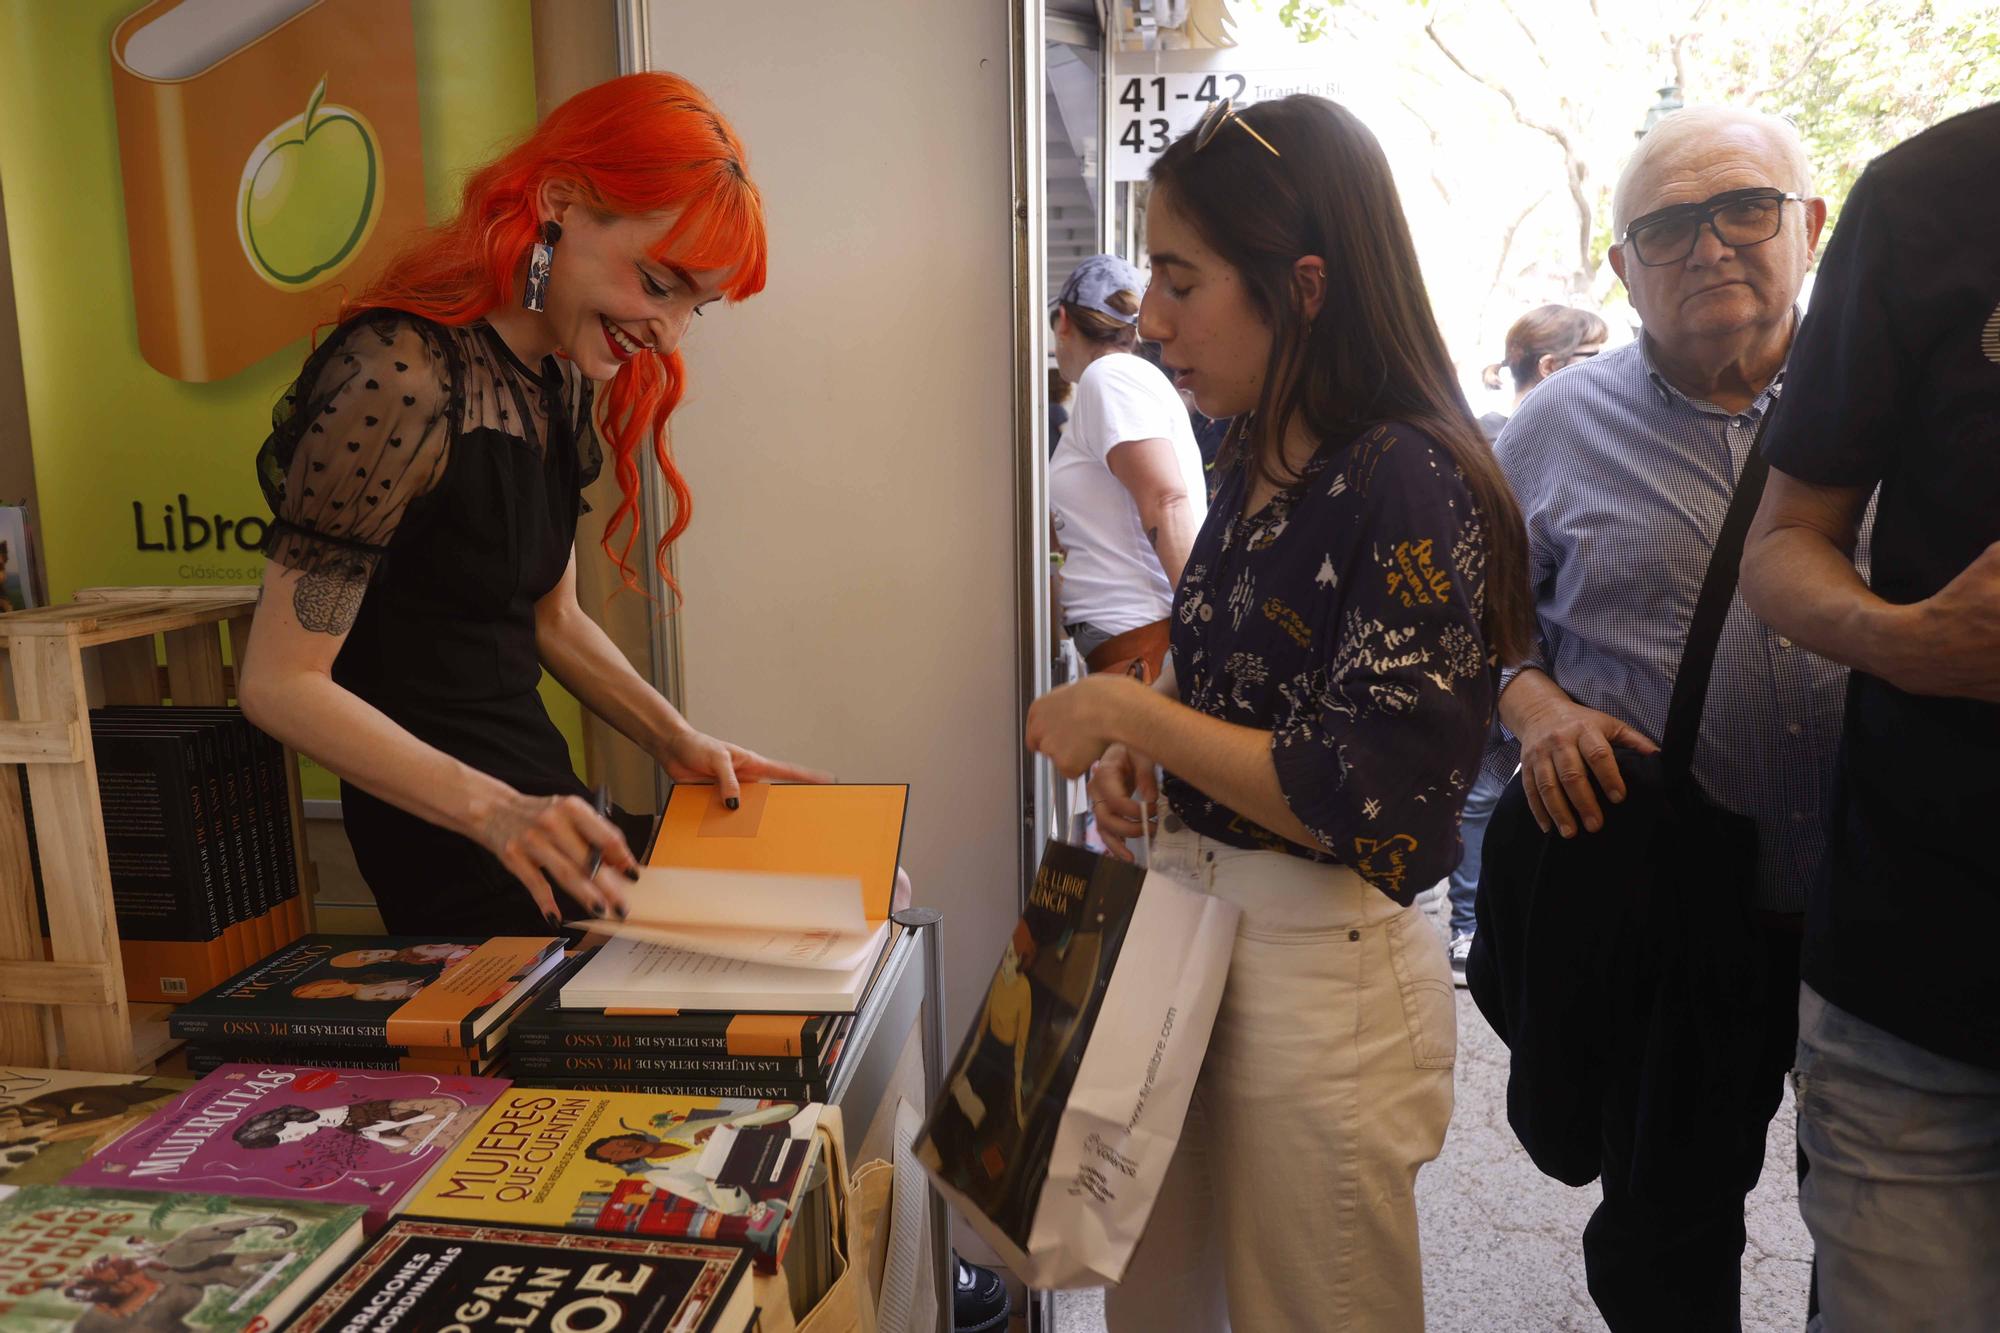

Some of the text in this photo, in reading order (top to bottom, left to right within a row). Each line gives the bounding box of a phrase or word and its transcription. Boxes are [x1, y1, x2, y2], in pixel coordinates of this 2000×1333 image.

[1119, 73, 1247, 112] 41-42
[178, 564, 242, 580] Clásicos
[222, 1021, 289, 1036] PICASSO
[291, 1024, 309, 1035] DE
[309, 1024, 356, 1037] DETRÁS
[564, 1033, 631, 1048] PICASSO
[634, 1035, 651, 1048] DE
[653, 1036, 700, 1049] DETRÁS
[565, 1057, 781, 1073] LAS MUJERES DETRÁS DE PICASSO
[709, 1084, 764, 1098] MUJERES
[765, 1085, 788, 1098] LAS
[129, 1068, 298, 1178] MUJERCITAS
[436, 1097, 557, 1200] MUJERES
[496, 1165, 544, 1202] QUE
[524, 1098, 591, 1163] CUENTAN
